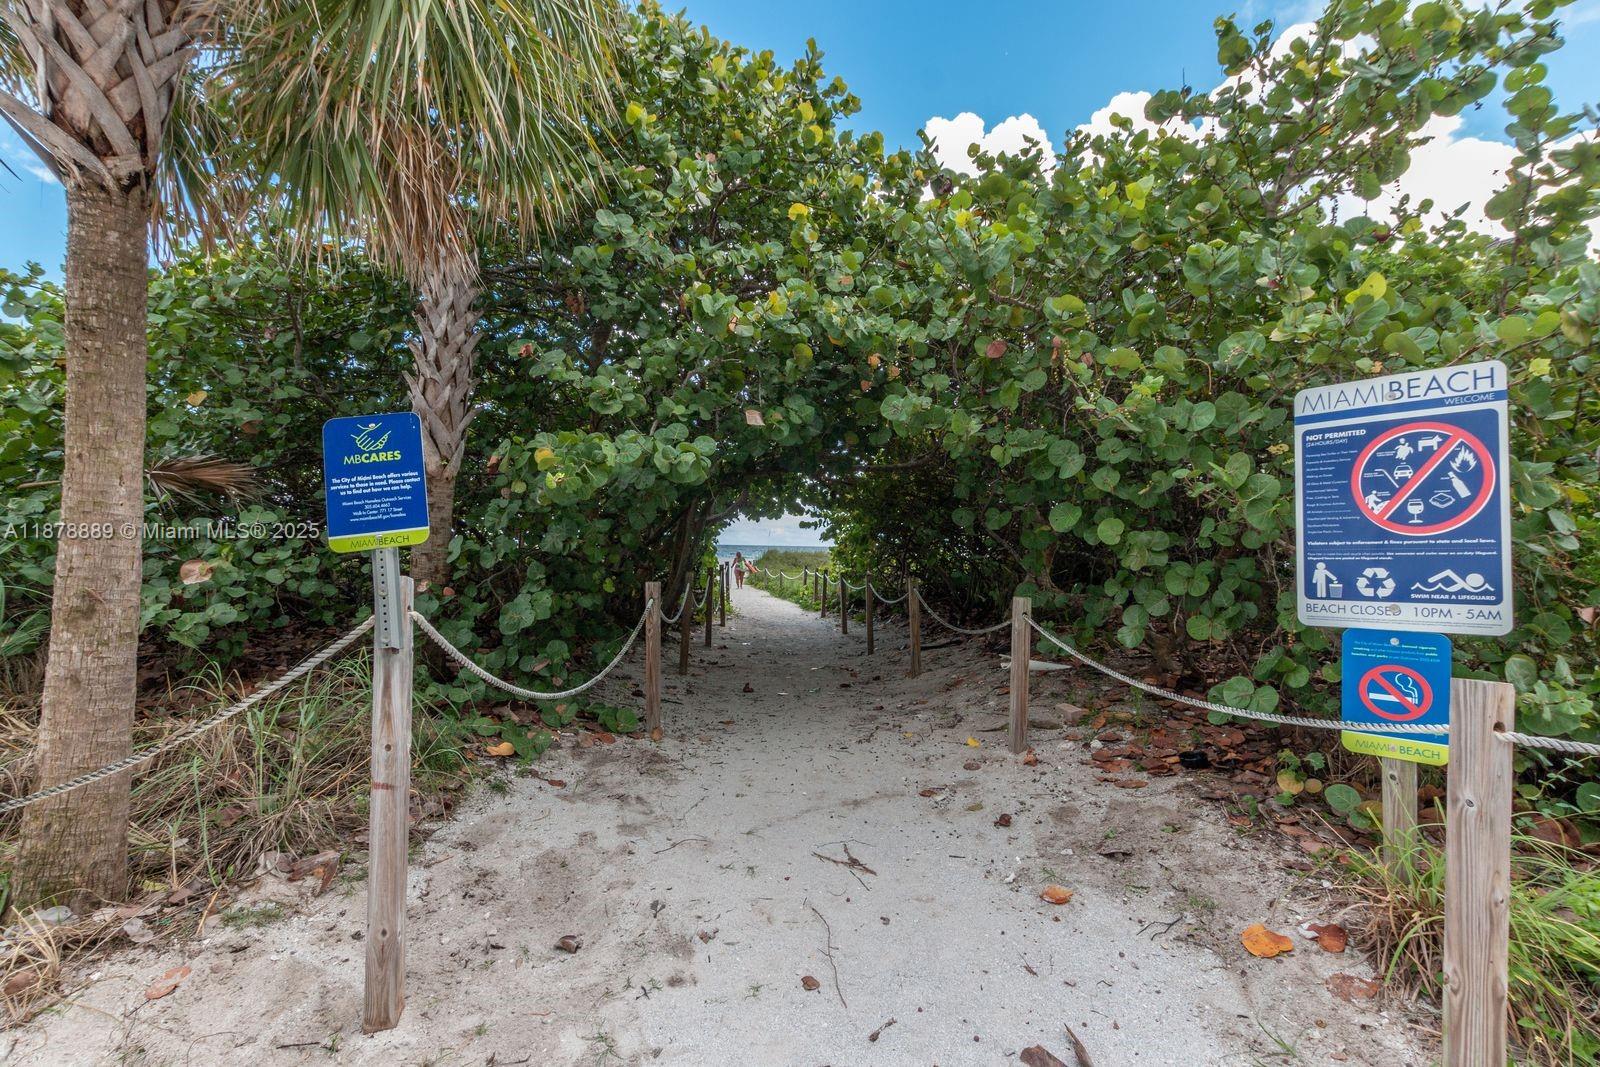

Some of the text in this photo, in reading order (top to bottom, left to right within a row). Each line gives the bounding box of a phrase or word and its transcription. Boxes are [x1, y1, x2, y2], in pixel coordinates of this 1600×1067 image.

[1444, 393, 1495, 405] WELCOME
[1325, 429, 1366, 439] PERMITTED
[344, 451, 401, 464] MBCARES
[1306, 603, 1346, 613] BEACH
[1414, 607, 1452, 618] 10PM
[1466, 609, 1502, 620] 5AM
[1399, 745, 1440, 760] BEACH
